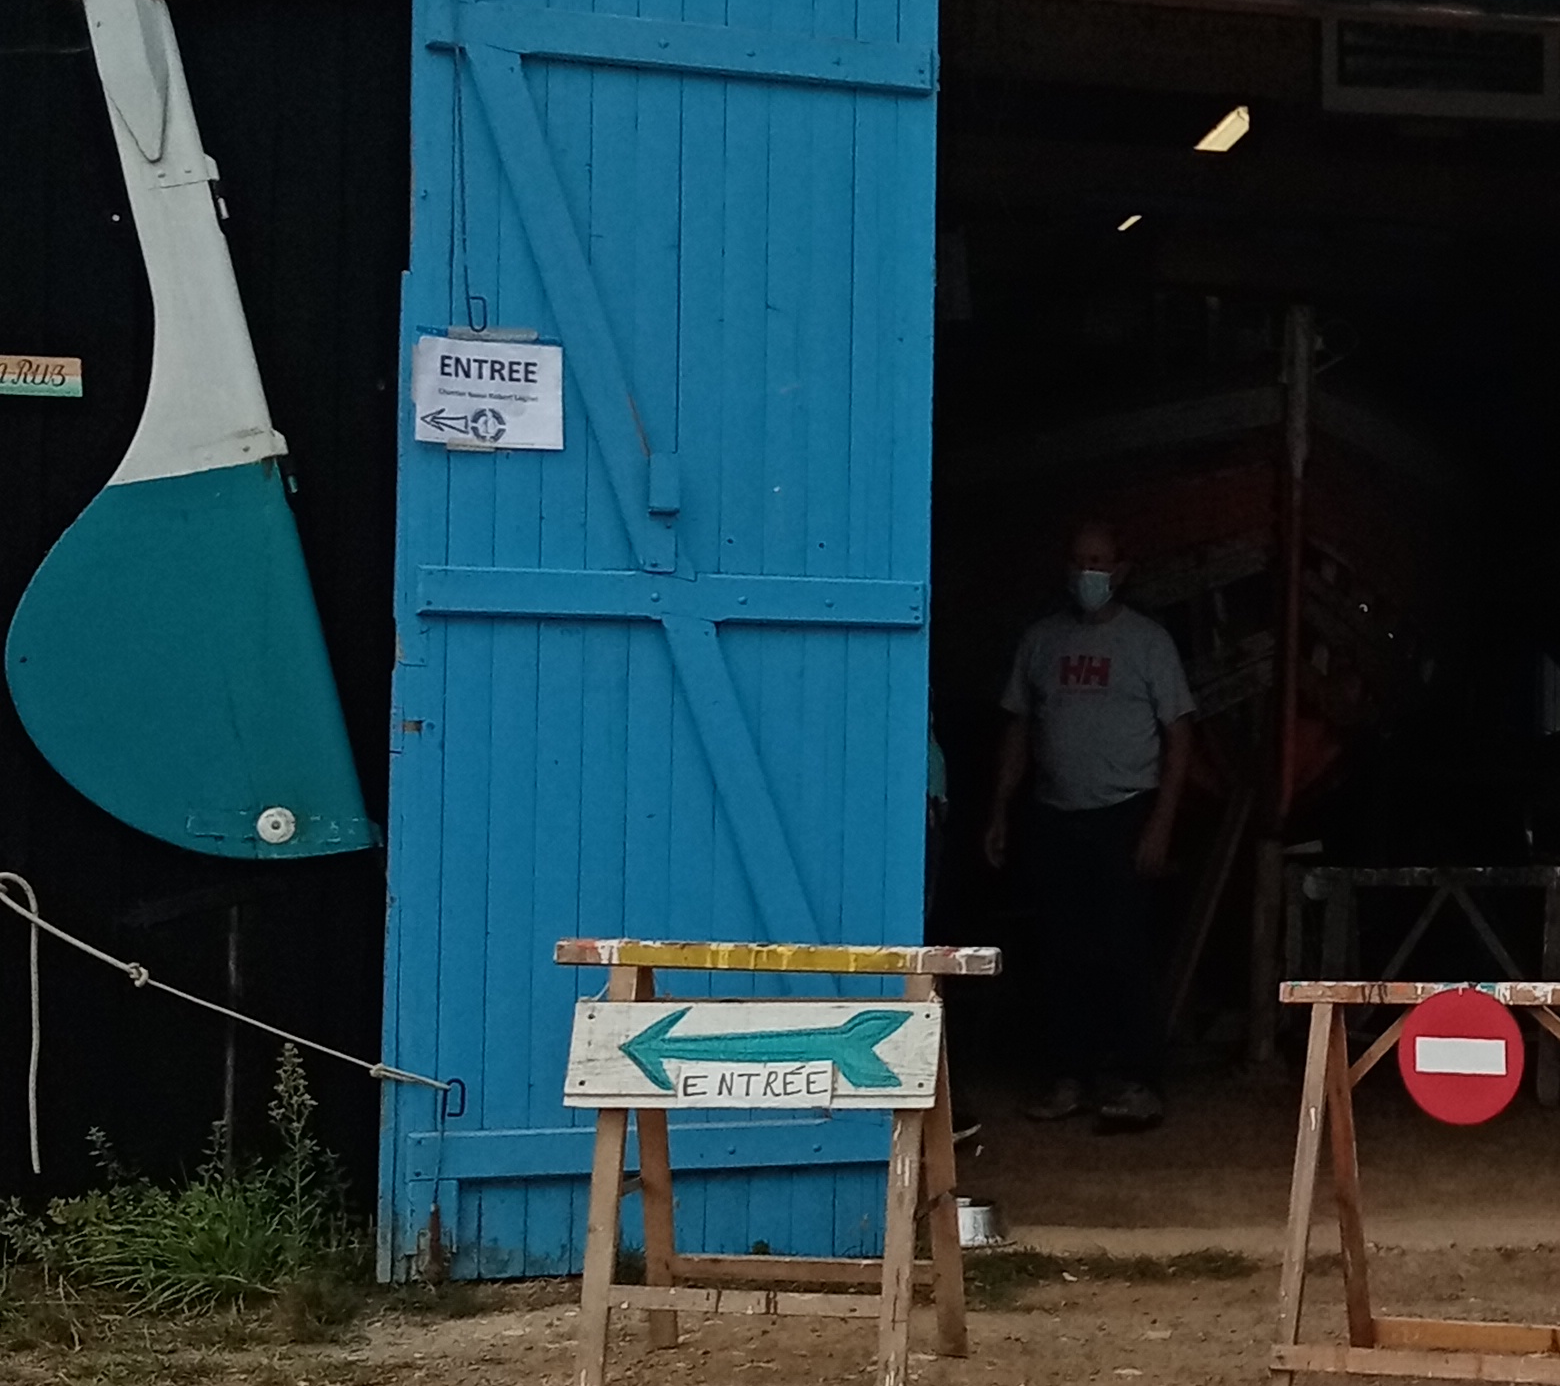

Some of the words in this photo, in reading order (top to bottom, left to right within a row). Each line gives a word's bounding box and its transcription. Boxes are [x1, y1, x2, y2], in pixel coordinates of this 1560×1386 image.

[440, 355, 538, 384] ENTREE
[1059, 655, 1111, 686] HH
[682, 1064, 830, 1098] ENTRÉE
